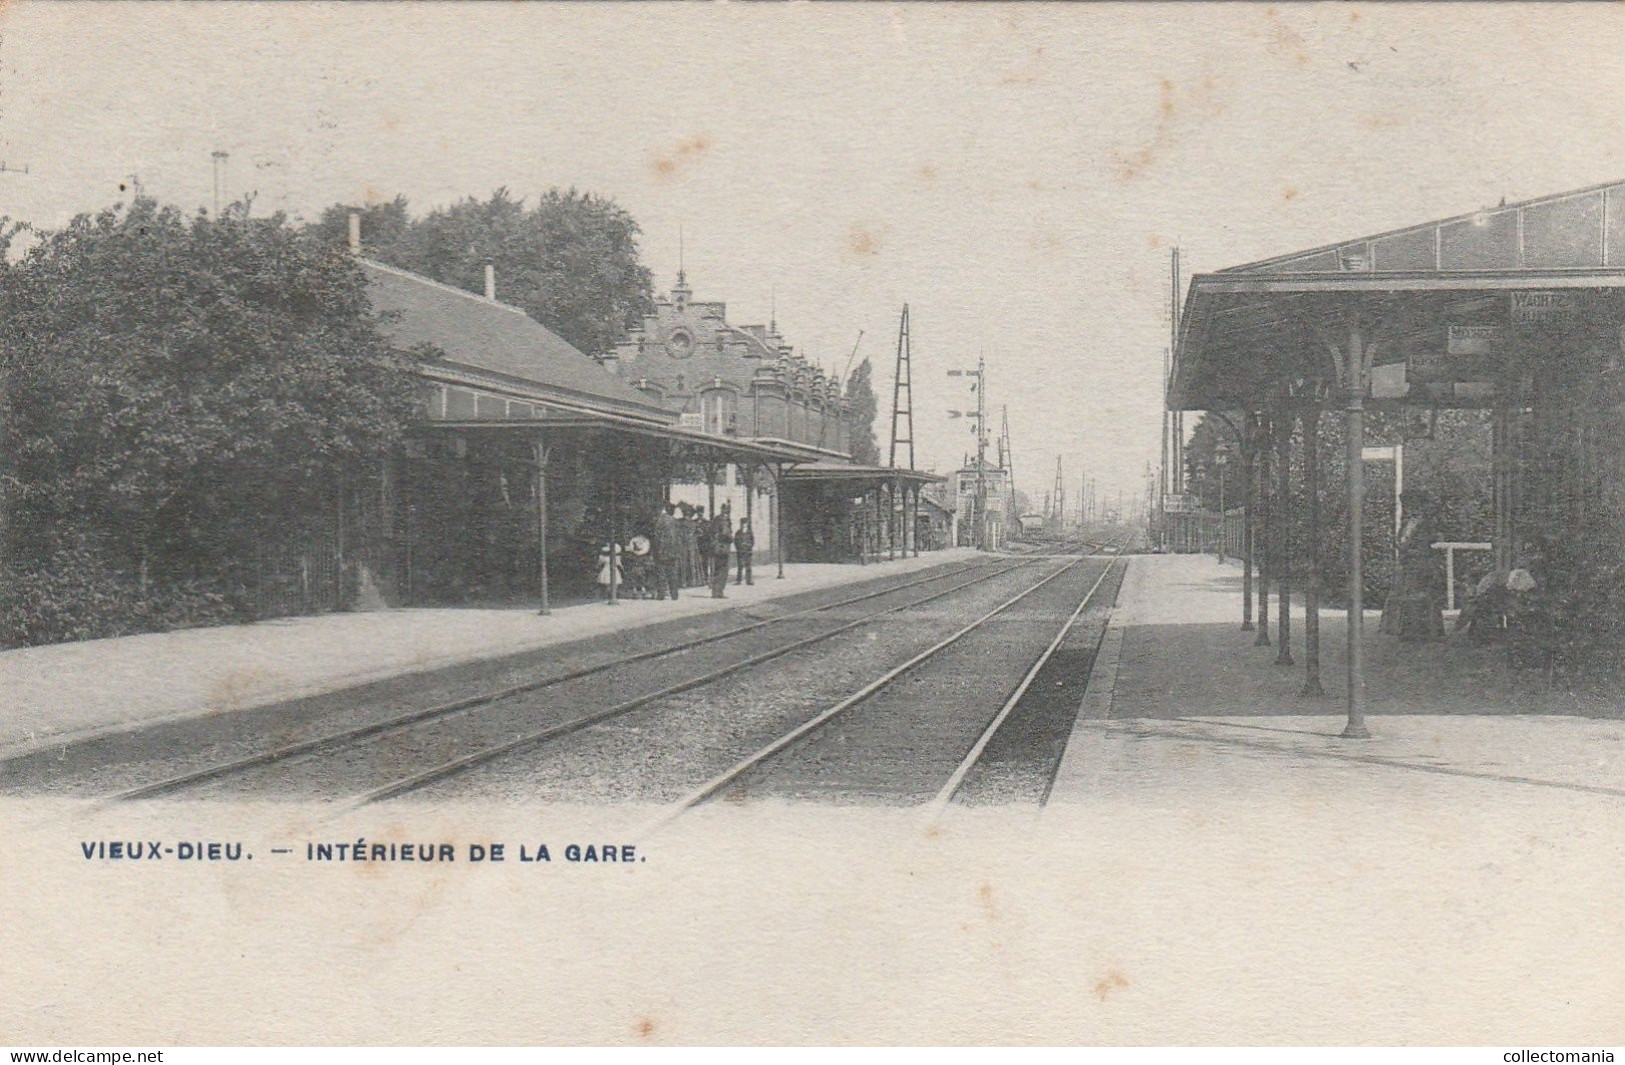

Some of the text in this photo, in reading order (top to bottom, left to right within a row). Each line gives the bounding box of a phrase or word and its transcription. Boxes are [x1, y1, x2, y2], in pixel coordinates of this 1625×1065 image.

[82, 842, 252, 860] VIEUX-DIEU.
[308, 838, 454, 861] INTÉRIEUR
[470, 844, 504, 862] DE
[520, 845, 550, 861] LA
[565, 845, 645, 862] GARE.
